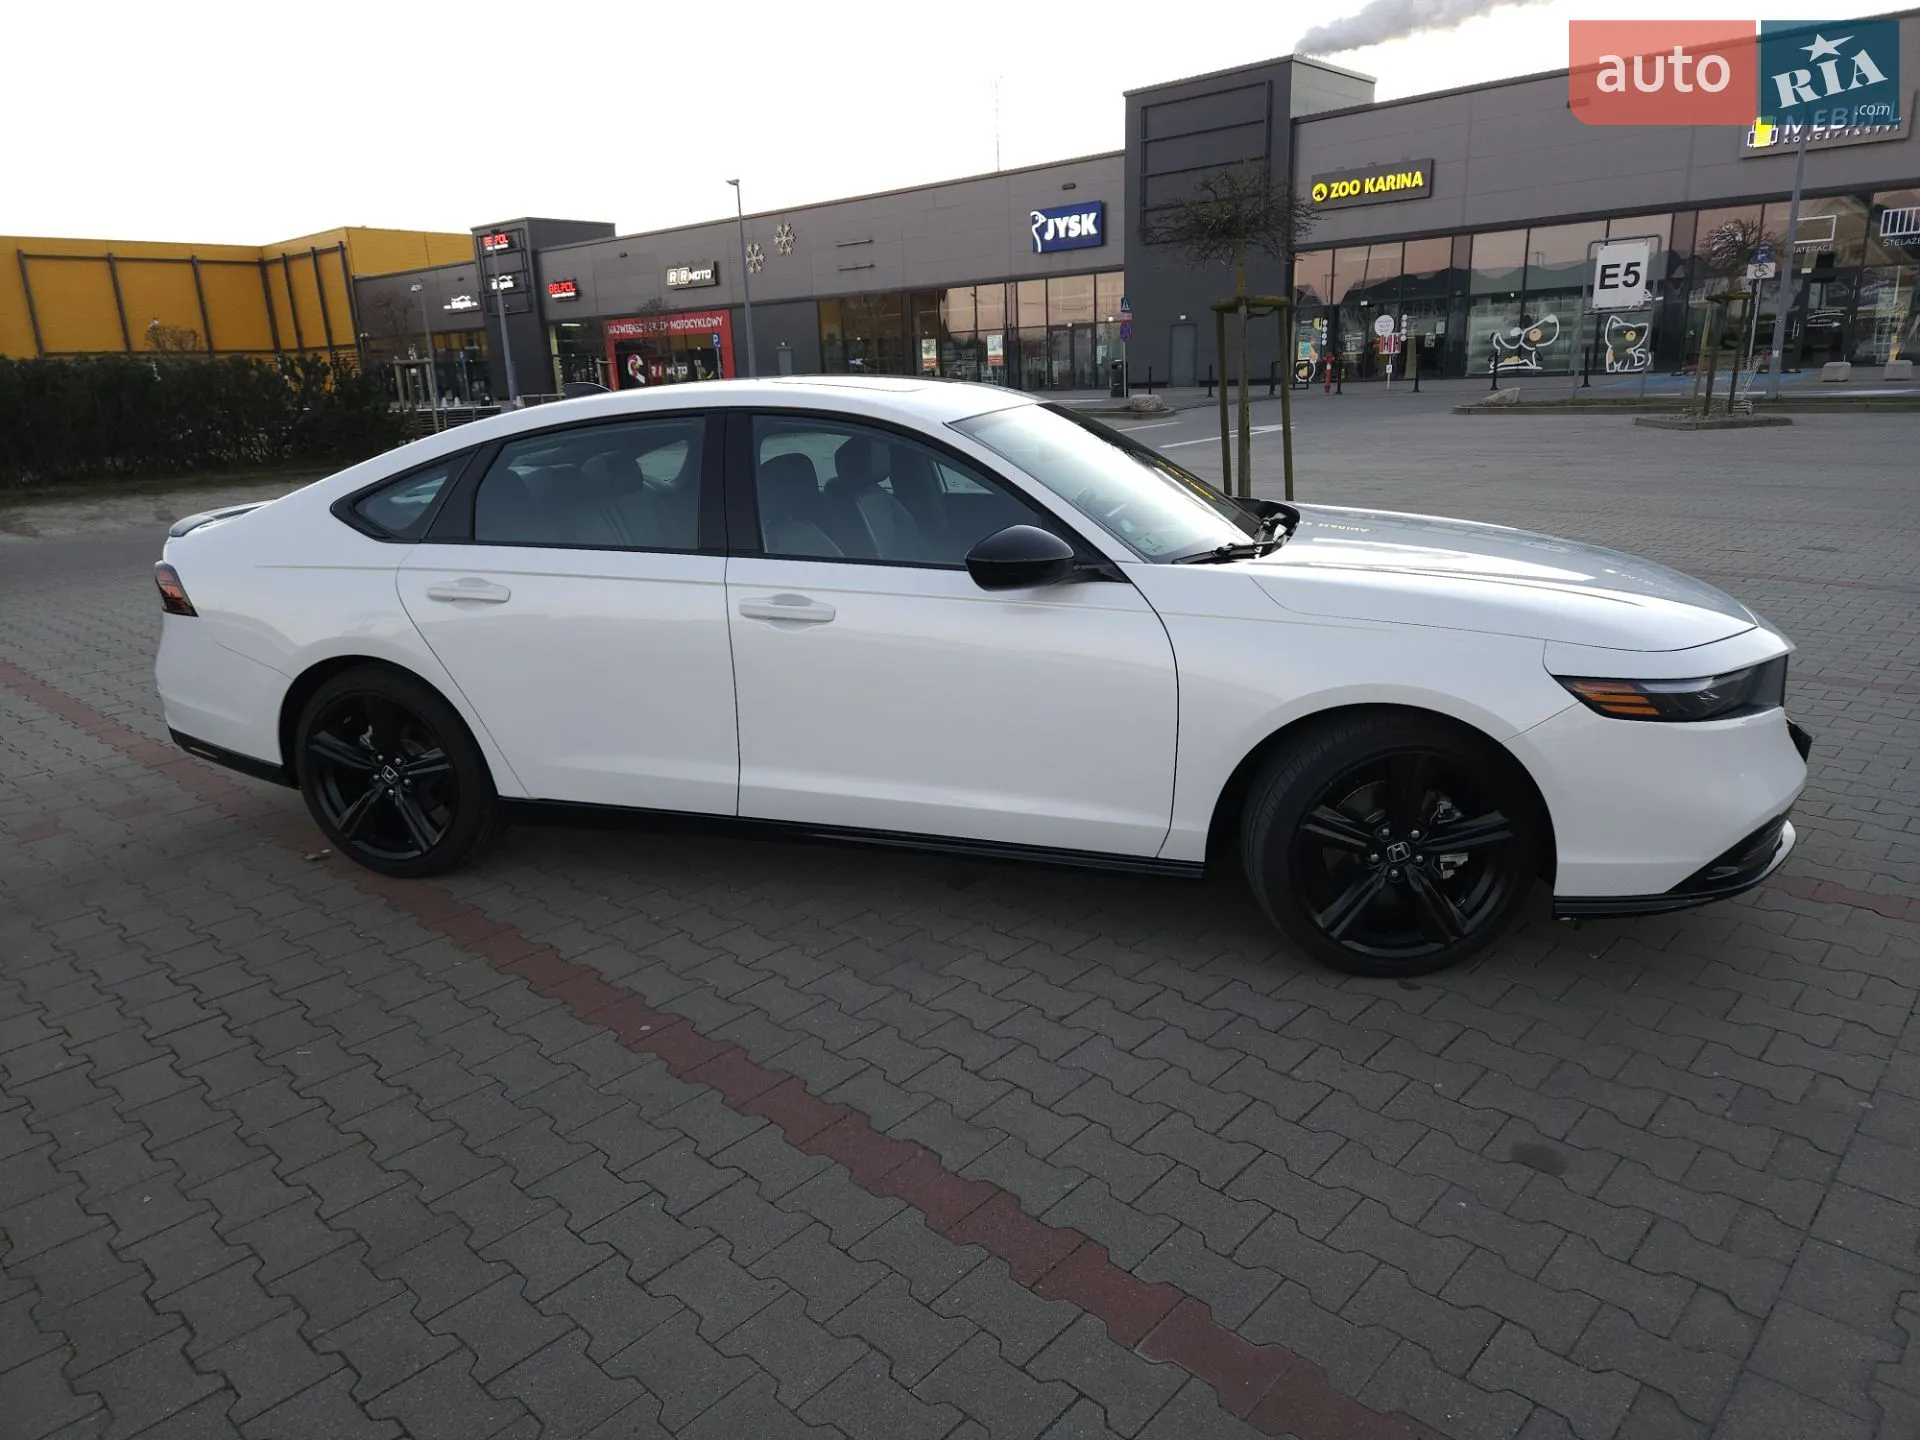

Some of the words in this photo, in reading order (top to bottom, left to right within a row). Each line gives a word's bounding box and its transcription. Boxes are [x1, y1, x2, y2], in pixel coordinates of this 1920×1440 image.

[1329, 179, 1361, 199] ZOO
[1364, 170, 1424, 194] KARINA
[1044, 212, 1099, 241] JYSK
[1599, 262, 1641, 290] E5
[670, 316, 723, 330] MOTOCYKLOWY
